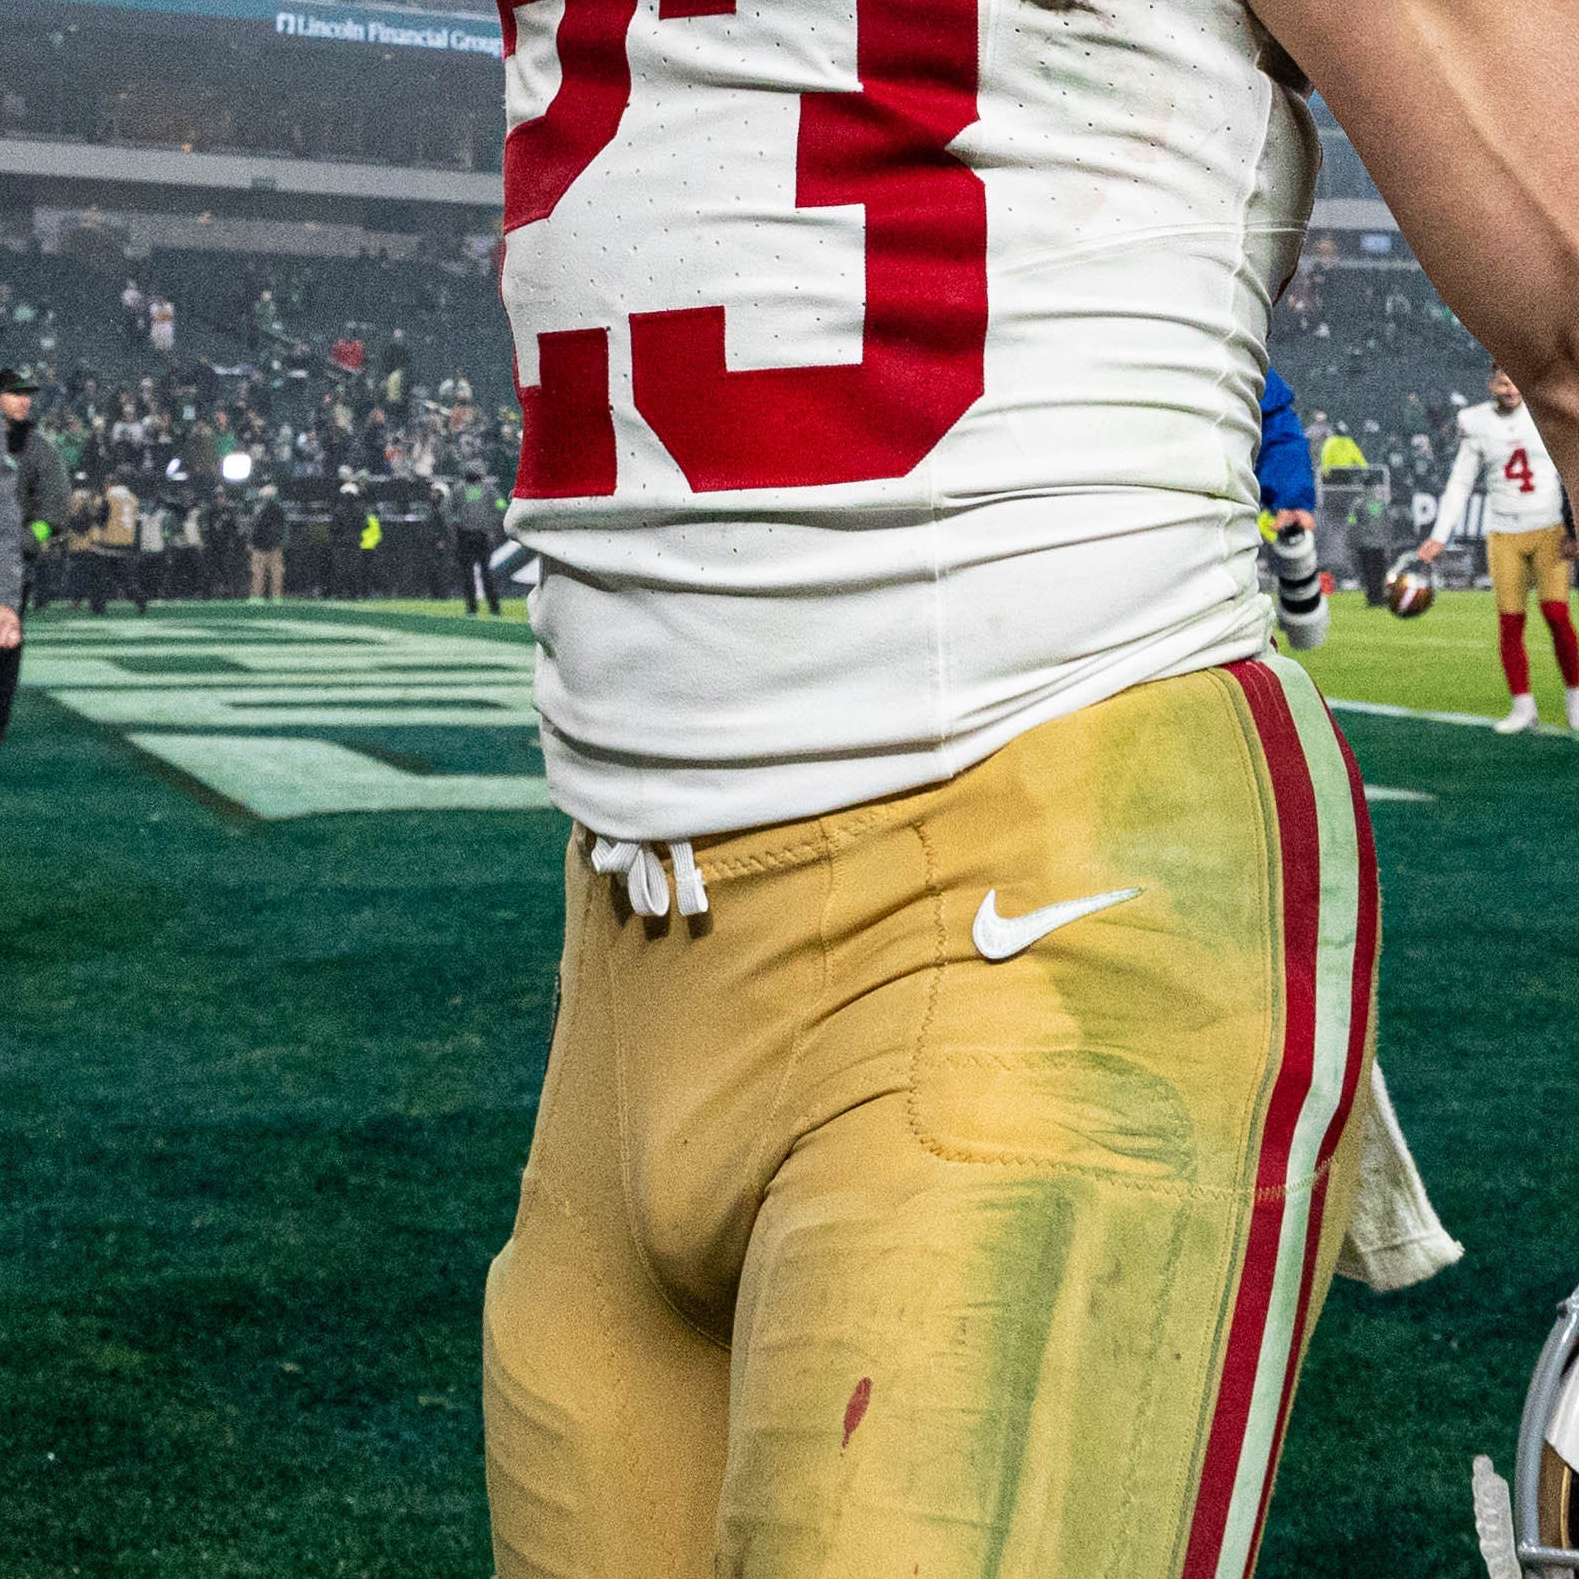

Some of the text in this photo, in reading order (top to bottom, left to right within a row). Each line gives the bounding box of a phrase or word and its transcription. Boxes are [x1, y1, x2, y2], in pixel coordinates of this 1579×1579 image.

[297, 13, 366, 42] Lincoln
[367, 21, 449, 49] Financial
[1504, 447, 1535, 493] 4
